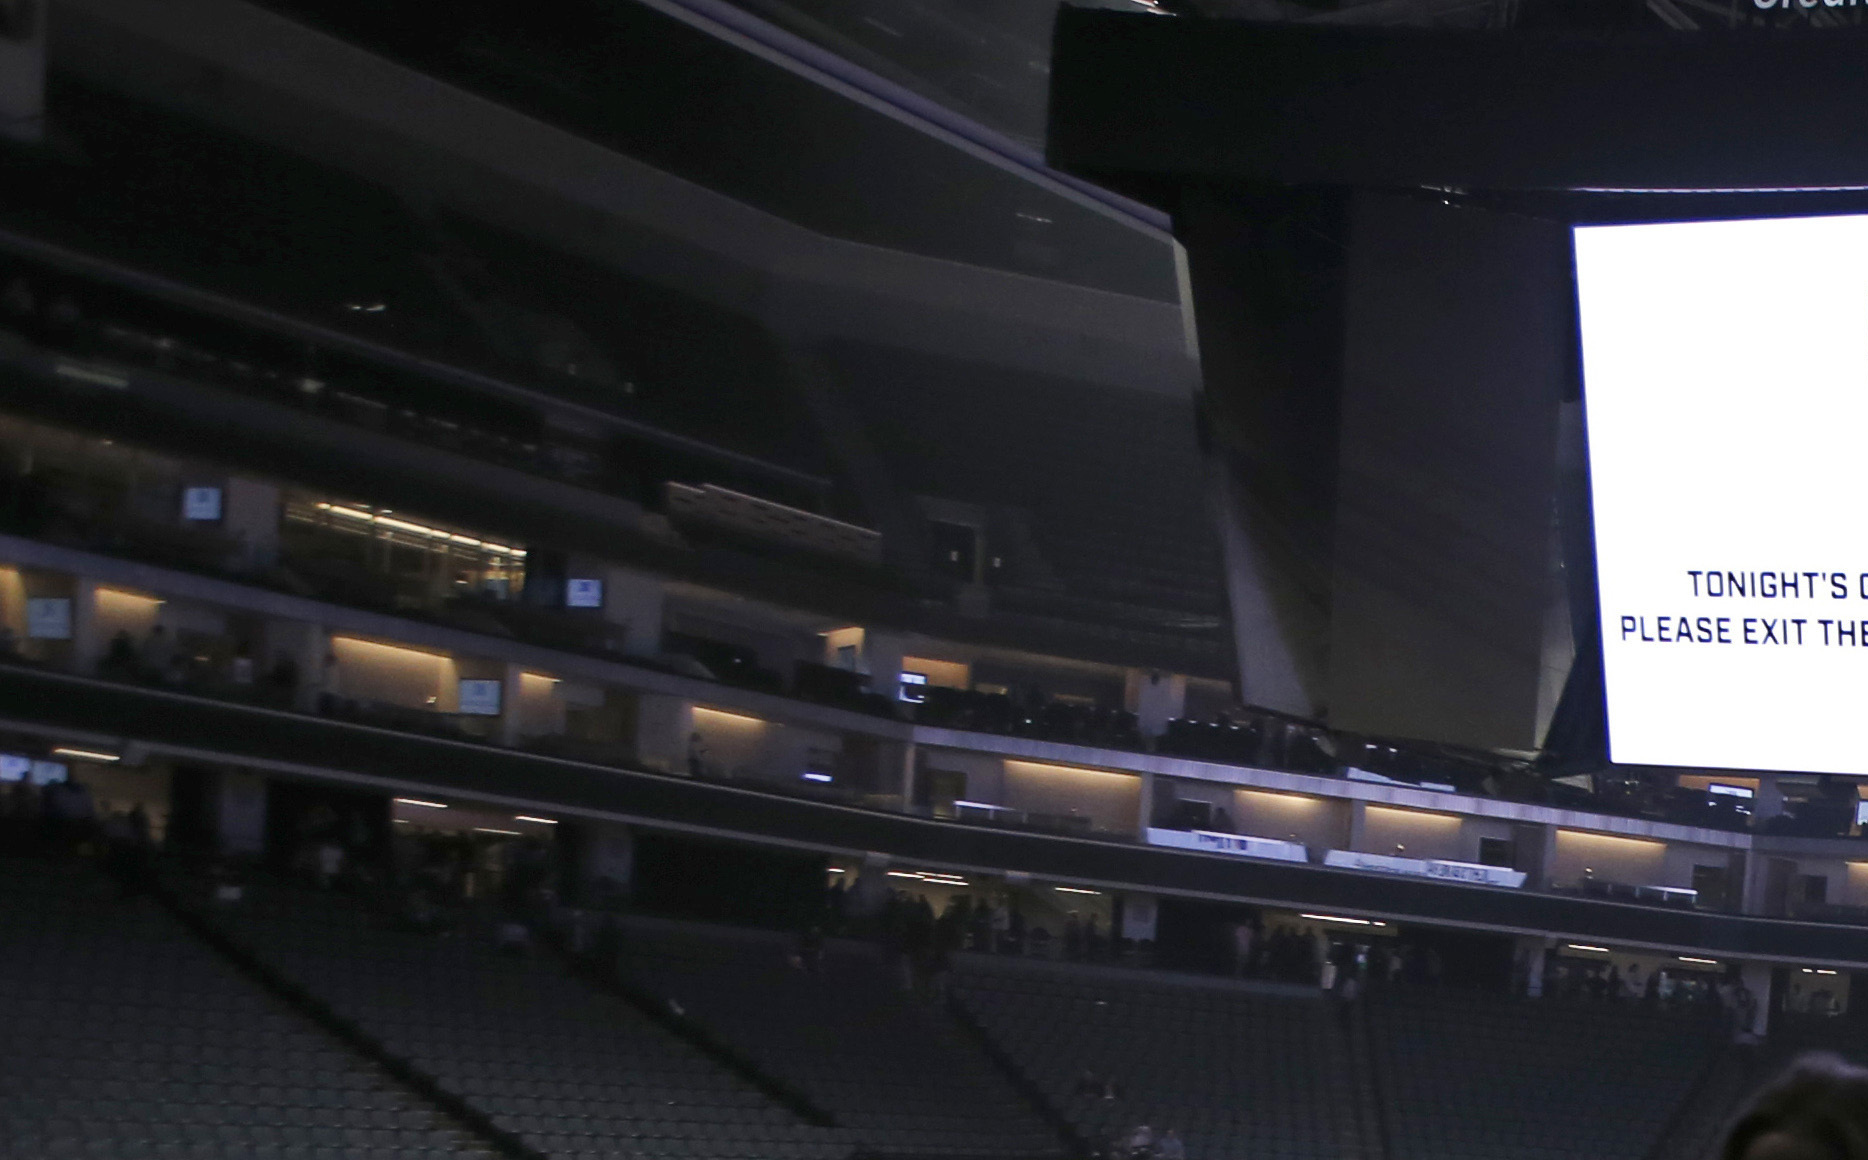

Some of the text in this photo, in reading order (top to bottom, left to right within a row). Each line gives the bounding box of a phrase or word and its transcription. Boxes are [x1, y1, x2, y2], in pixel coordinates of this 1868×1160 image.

[1687, 570, 1848, 600] TONIGHT'S
[1620, 615, 1732, 644] PLEASE
[1742, 617, 1808, 646] EXIT
